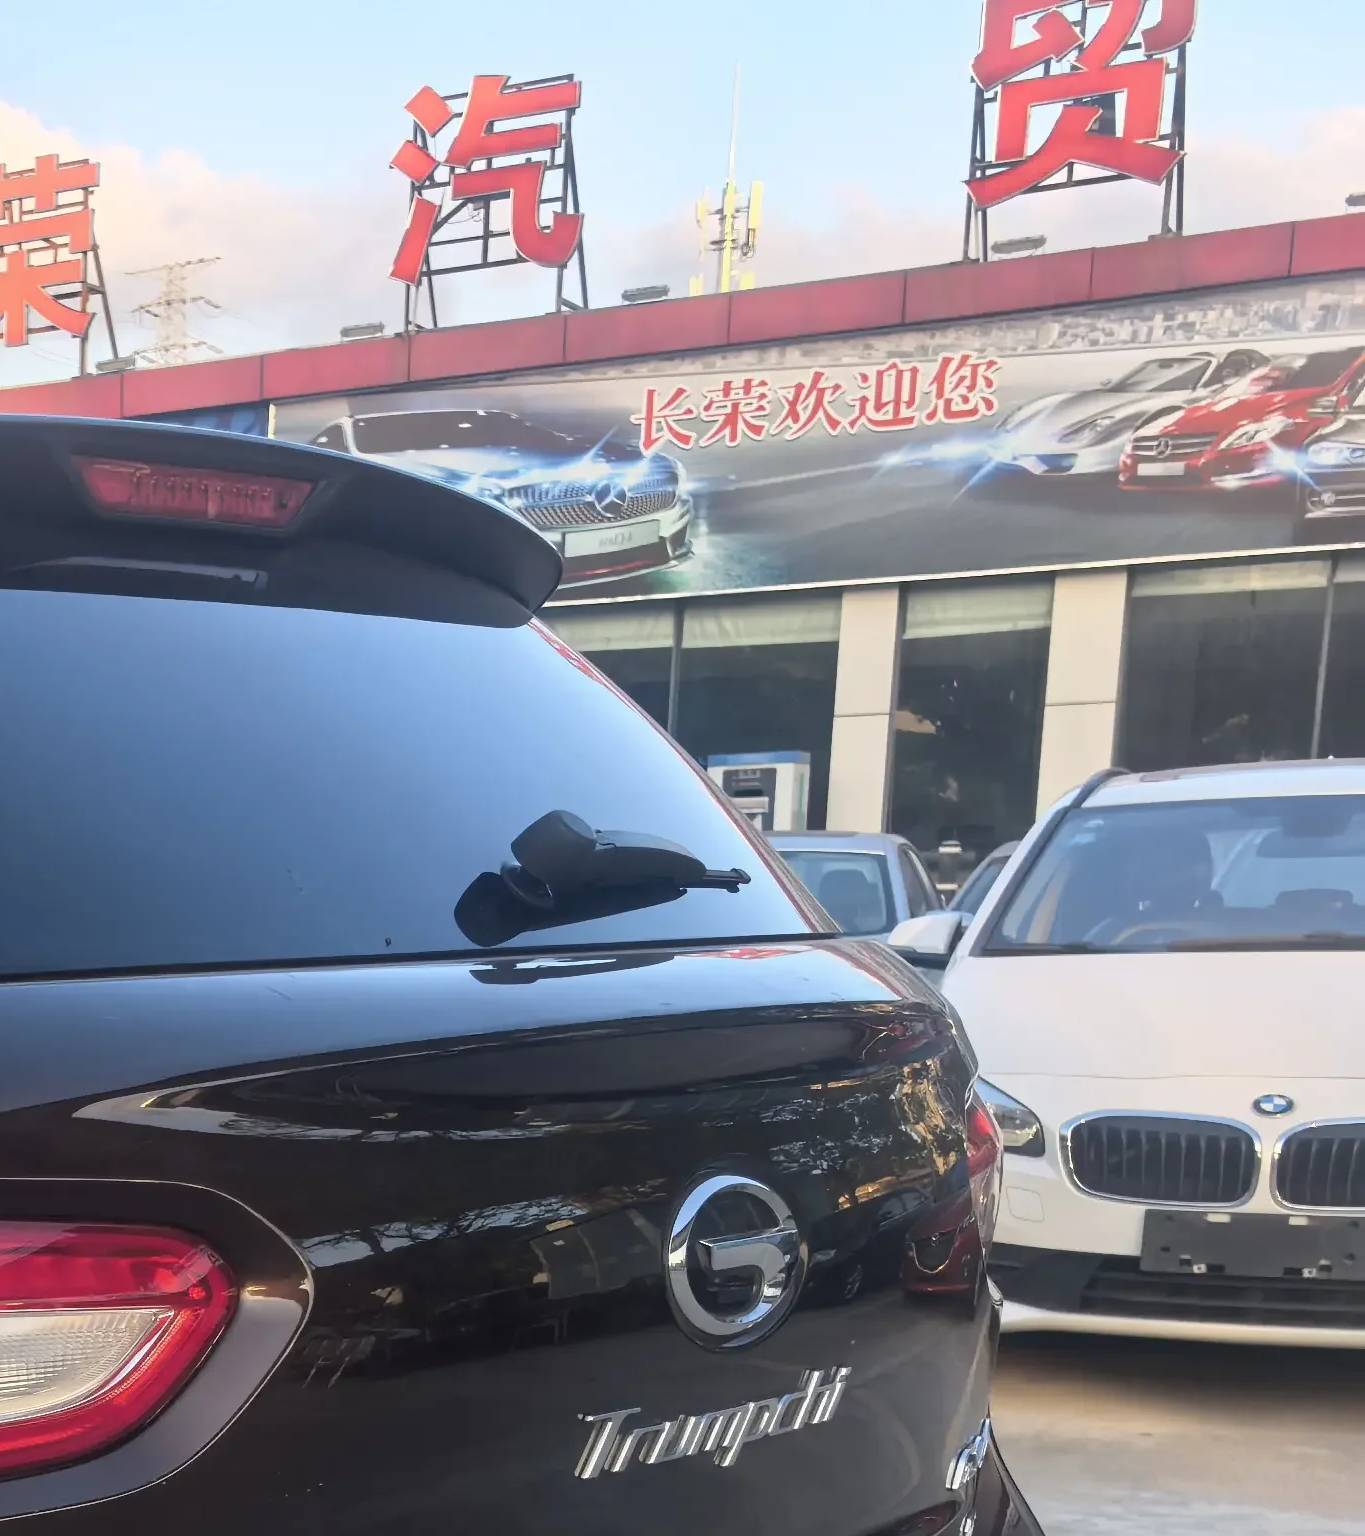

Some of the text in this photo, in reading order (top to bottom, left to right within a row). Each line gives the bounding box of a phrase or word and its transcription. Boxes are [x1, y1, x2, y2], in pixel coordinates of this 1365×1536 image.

[631, 352, 999, 455] 长荣欢迎您
[574, 1366, 852, 1479] Trumpchi
